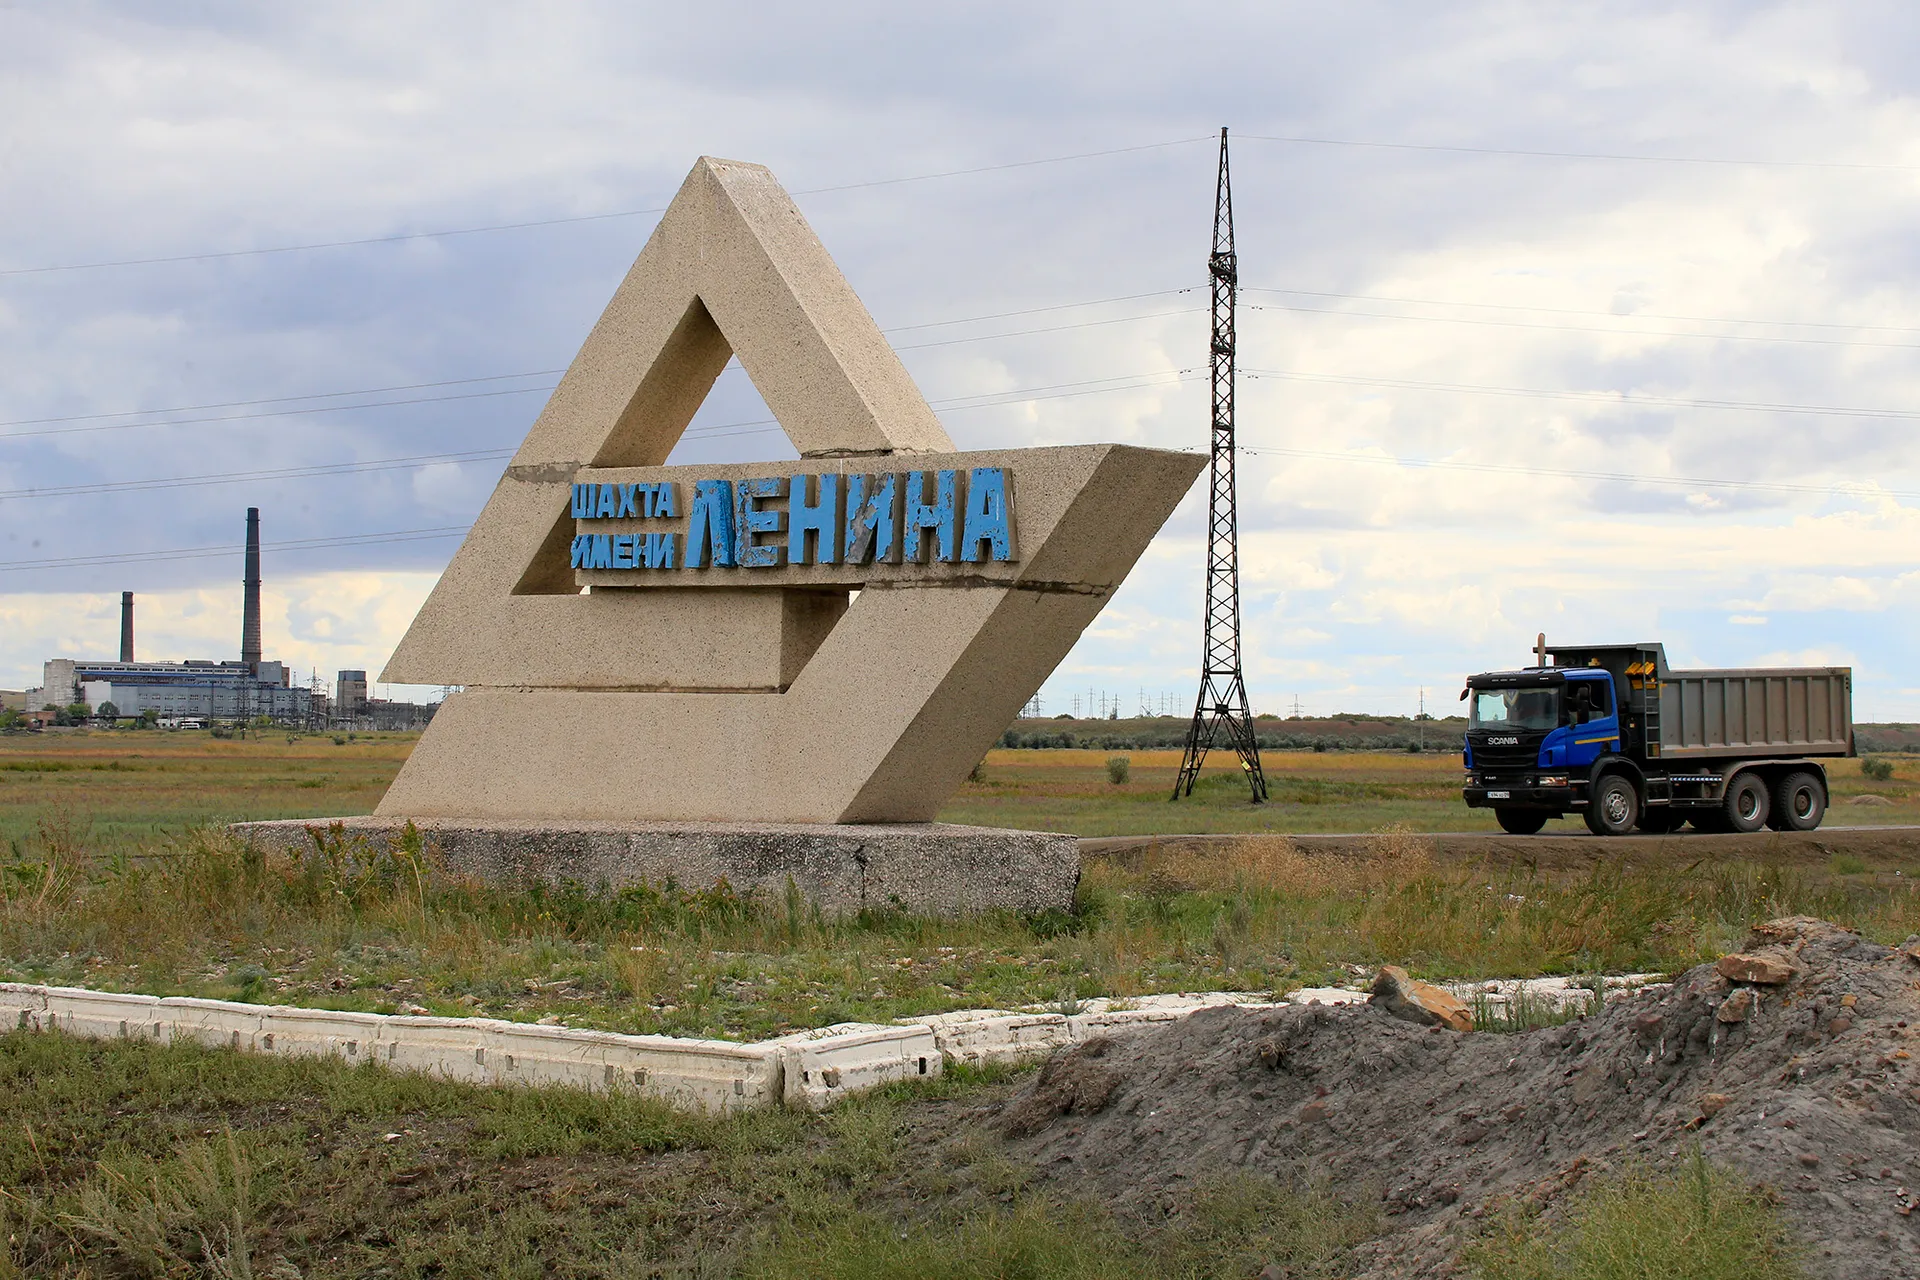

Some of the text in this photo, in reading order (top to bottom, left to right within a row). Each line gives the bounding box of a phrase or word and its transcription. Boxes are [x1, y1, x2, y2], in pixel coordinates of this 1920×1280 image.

[571, 482, 676, 519] ШАХТА
[684, 466, 1014, 568] ЛЕНИНА
[570, 533, 676, 569] ИМЕНИ
[1488, 737, 1518, 745] SCANIA
